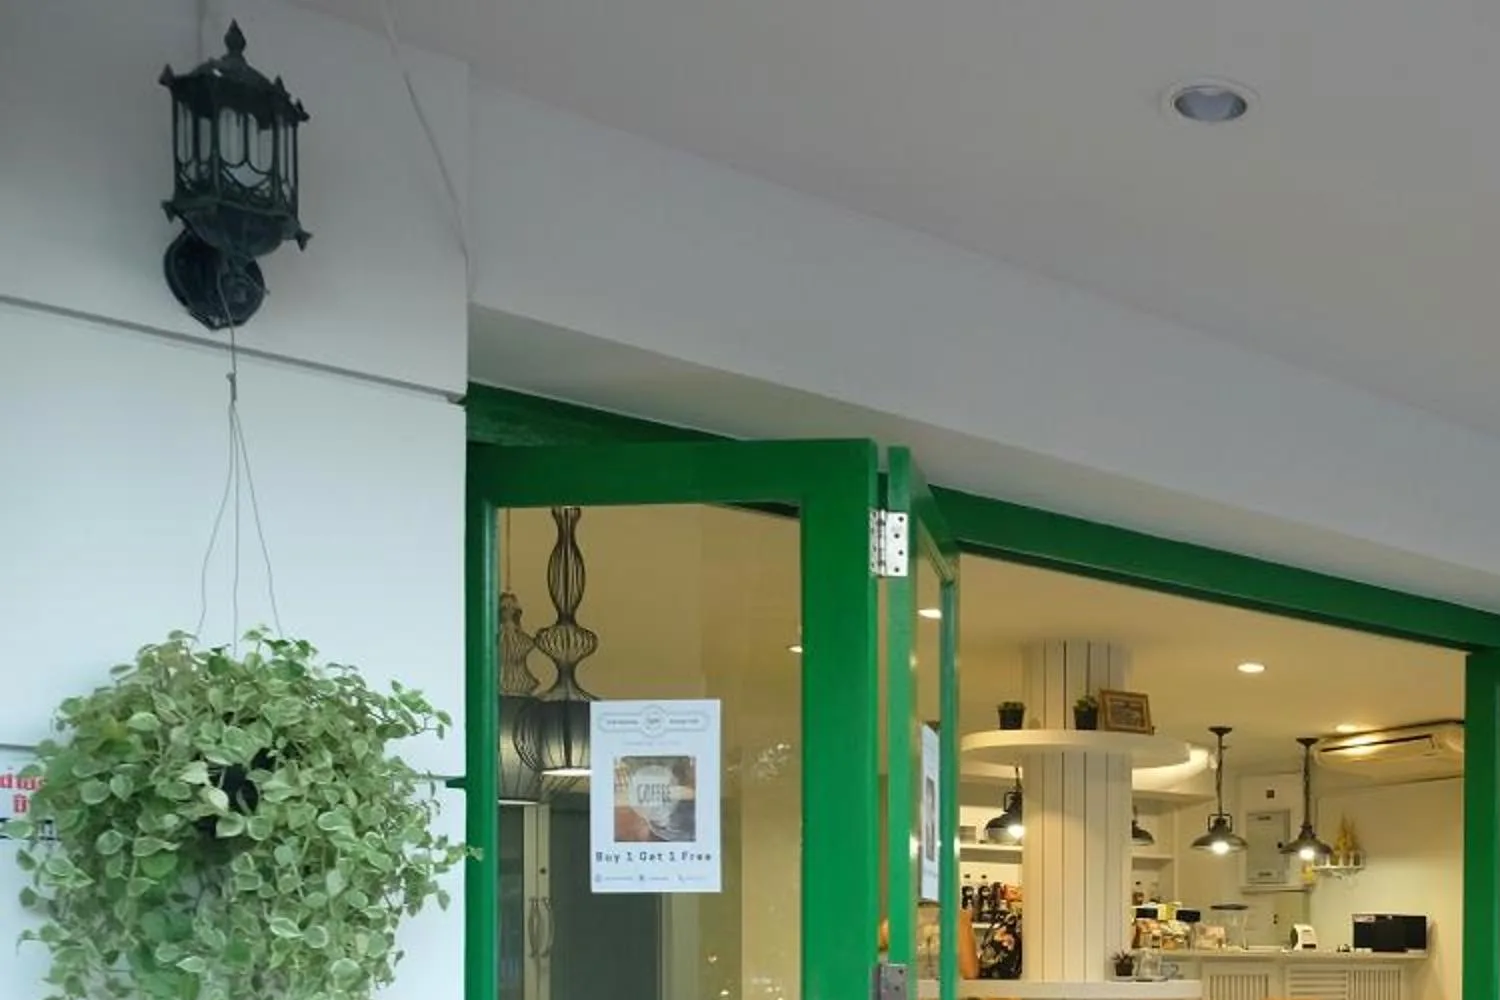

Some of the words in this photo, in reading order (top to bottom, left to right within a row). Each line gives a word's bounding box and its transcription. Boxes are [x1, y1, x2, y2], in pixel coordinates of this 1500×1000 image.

[595, 851, 619, 864] Buy
[639, 851, 663, 861] Get
[681, 851, 711, 861] Free
